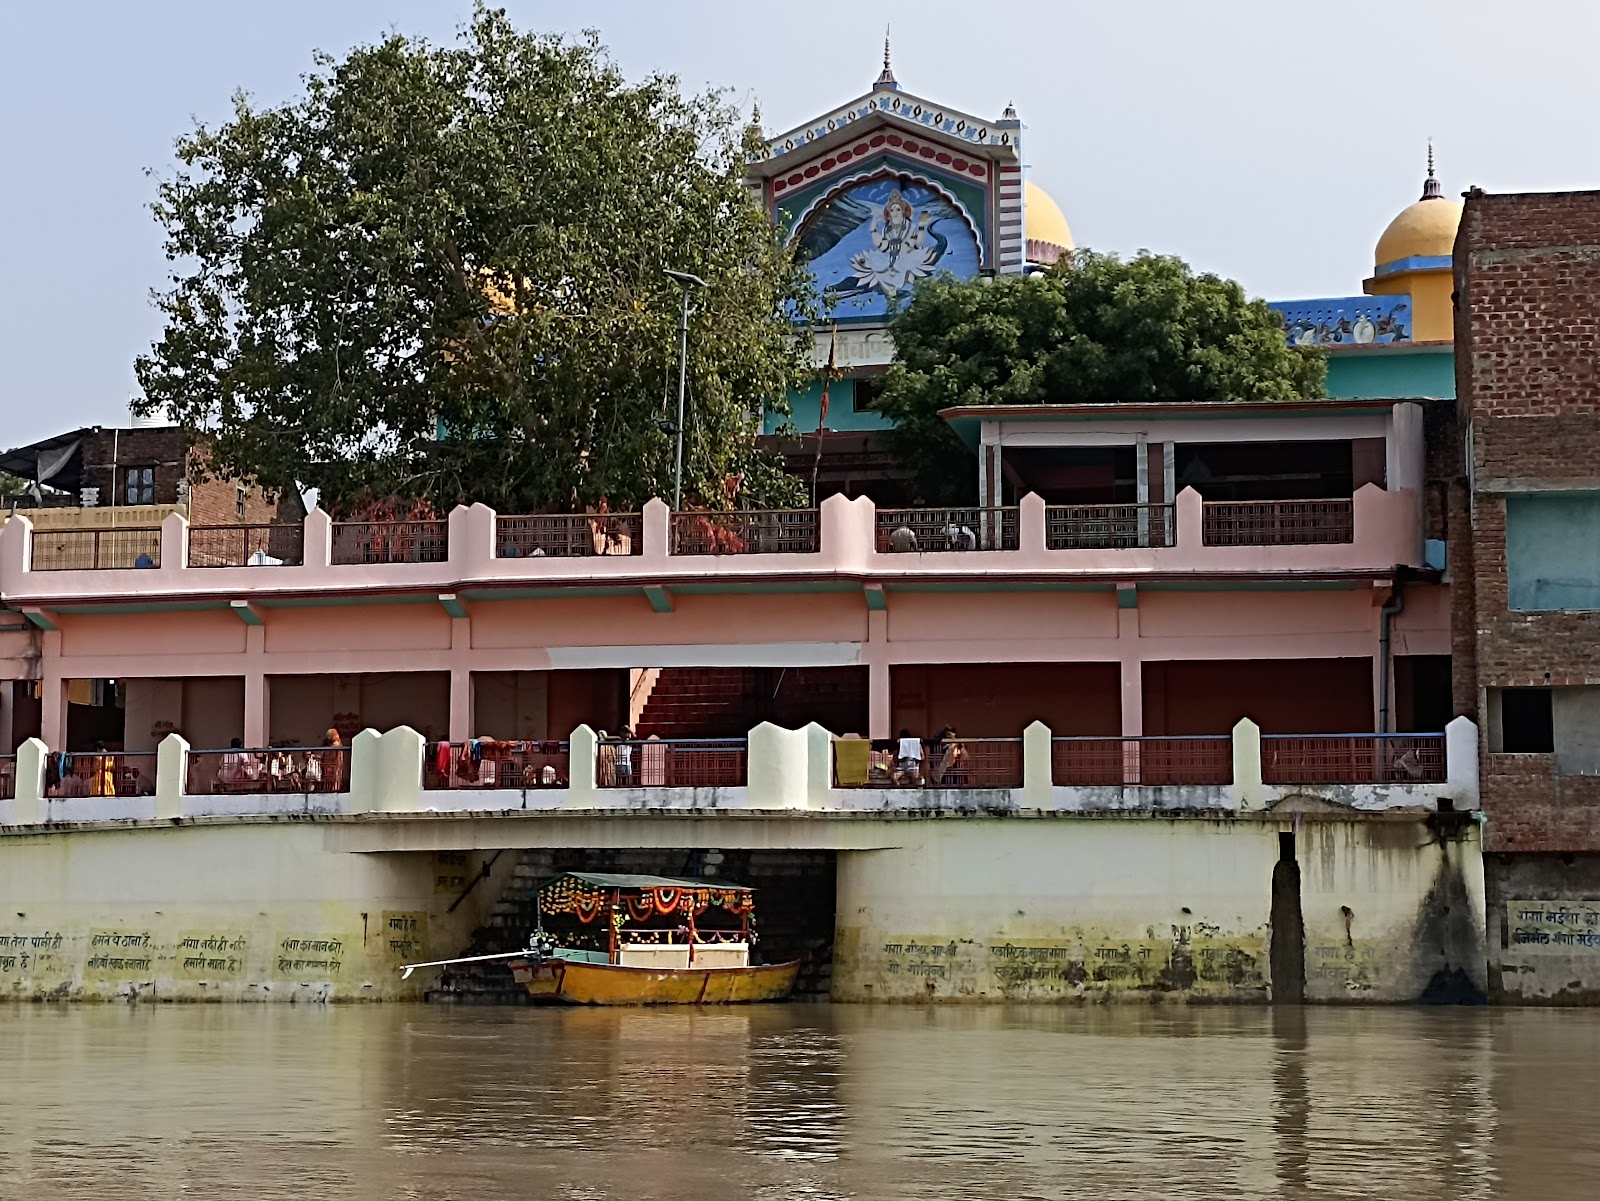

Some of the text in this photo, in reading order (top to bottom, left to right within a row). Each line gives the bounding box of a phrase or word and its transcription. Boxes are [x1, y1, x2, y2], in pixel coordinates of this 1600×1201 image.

[389, 914, 402, 930] गंगा
[1517, 907, 1544, 922] गंगा
[11, 932, 28, 949] तेरा
[31, 931, 53, 948] पानी
[52, 932, 63, 950] ही
[92, 932, 110, 949] हमने
[111, 932, 122, 946] ये
[122, 935, 142, 947] ठाना
[181, 936, 200, 949] गंगा
[201, 935, 218, 952] नदी
[217, 936, 229, 953] ही
[281, 937, 300, 951] गंगा
[300, 940, 313, 952] का
[311, 940, 329, 952] मान
[991, 943, 1067, 964] प्लास्टिक मुक्त गंगा
[1094, 944, 1119, 959] गंगा
[1138, 944, 1153, 961] तो
[1314, 943, 1340, 959] गंगा
[184, 952, 207, 974] हमारी
[208, 958, 226, 970] माता
[293, 959, 306, 971] का
